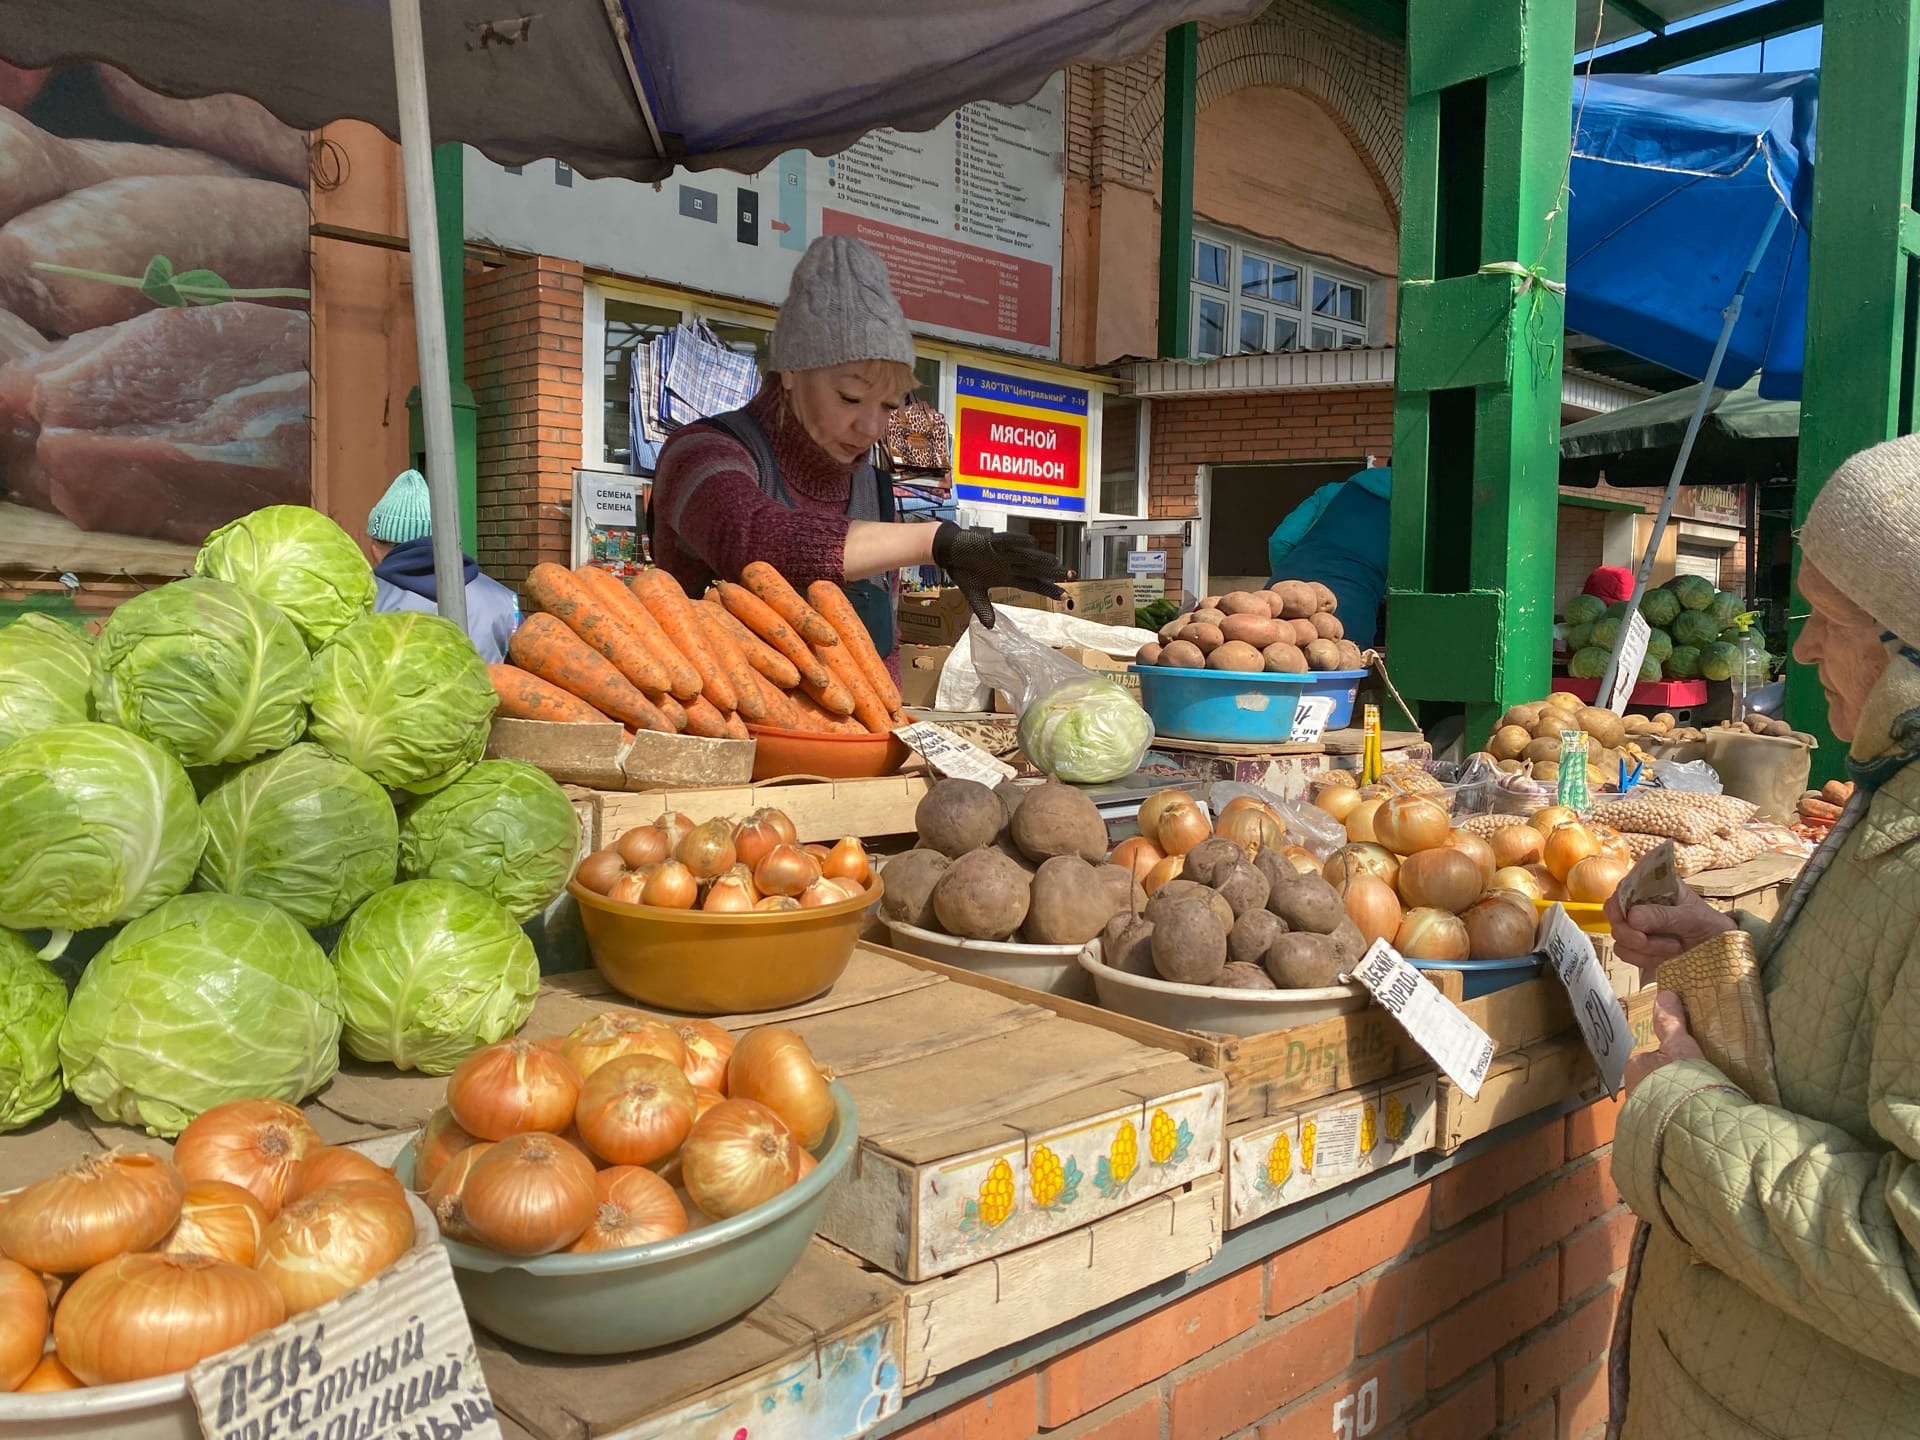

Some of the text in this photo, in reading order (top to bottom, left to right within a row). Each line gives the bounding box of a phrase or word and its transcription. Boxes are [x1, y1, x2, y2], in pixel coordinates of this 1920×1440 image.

[857, 224, 884, 239] Список
[886, 232, 925, 248] телефонов
[990, 424, 1057, 450] МЯСНОЙ
[980, 452, 1064, 480] ПАВИЛЬОН
[596, 502, 632, 512] СЕМЕНА
[597, 490, 632, 499] СЕМЕНА
[982, 489, 1059, 505] Мы всегда рады Вам!
[216, 1323, 324, 1429] ЛУК
[1332, 1376, 1378, 1440] 50
